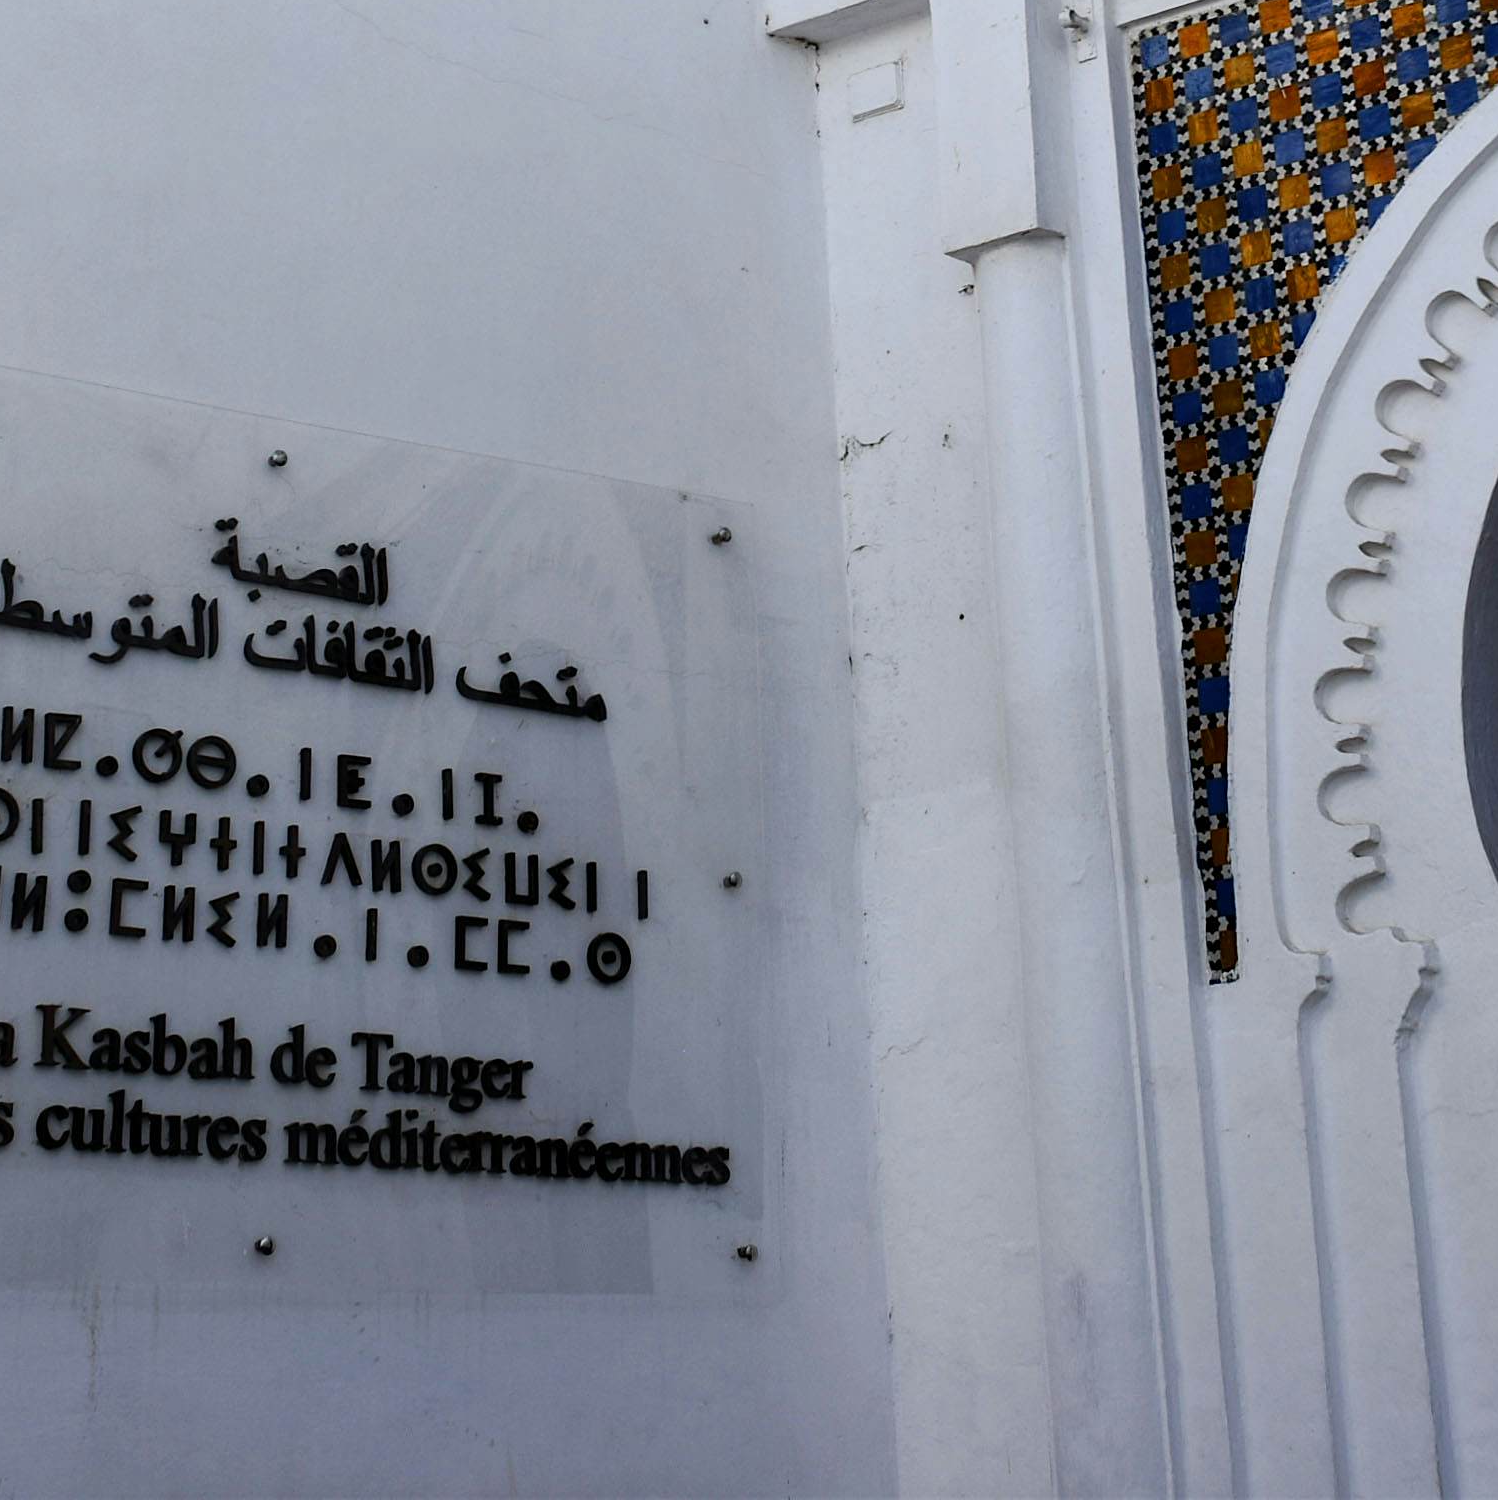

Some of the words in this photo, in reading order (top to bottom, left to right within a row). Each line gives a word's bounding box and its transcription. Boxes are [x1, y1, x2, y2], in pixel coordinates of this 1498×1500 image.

[210, 517, 389, 608] القصبة
[242, 614, 435, 696] الثقافات
[455, 651, 608, 725] متحف
[34, 1003, 255, 1083] Kasbah
[269, 1023, 338, 1091] de
[350, 1031, 534, 1115] Tanger
[35, 1089, 268, 1167] cultures
[282, 1106, 731, 1191] méditerranéennes
